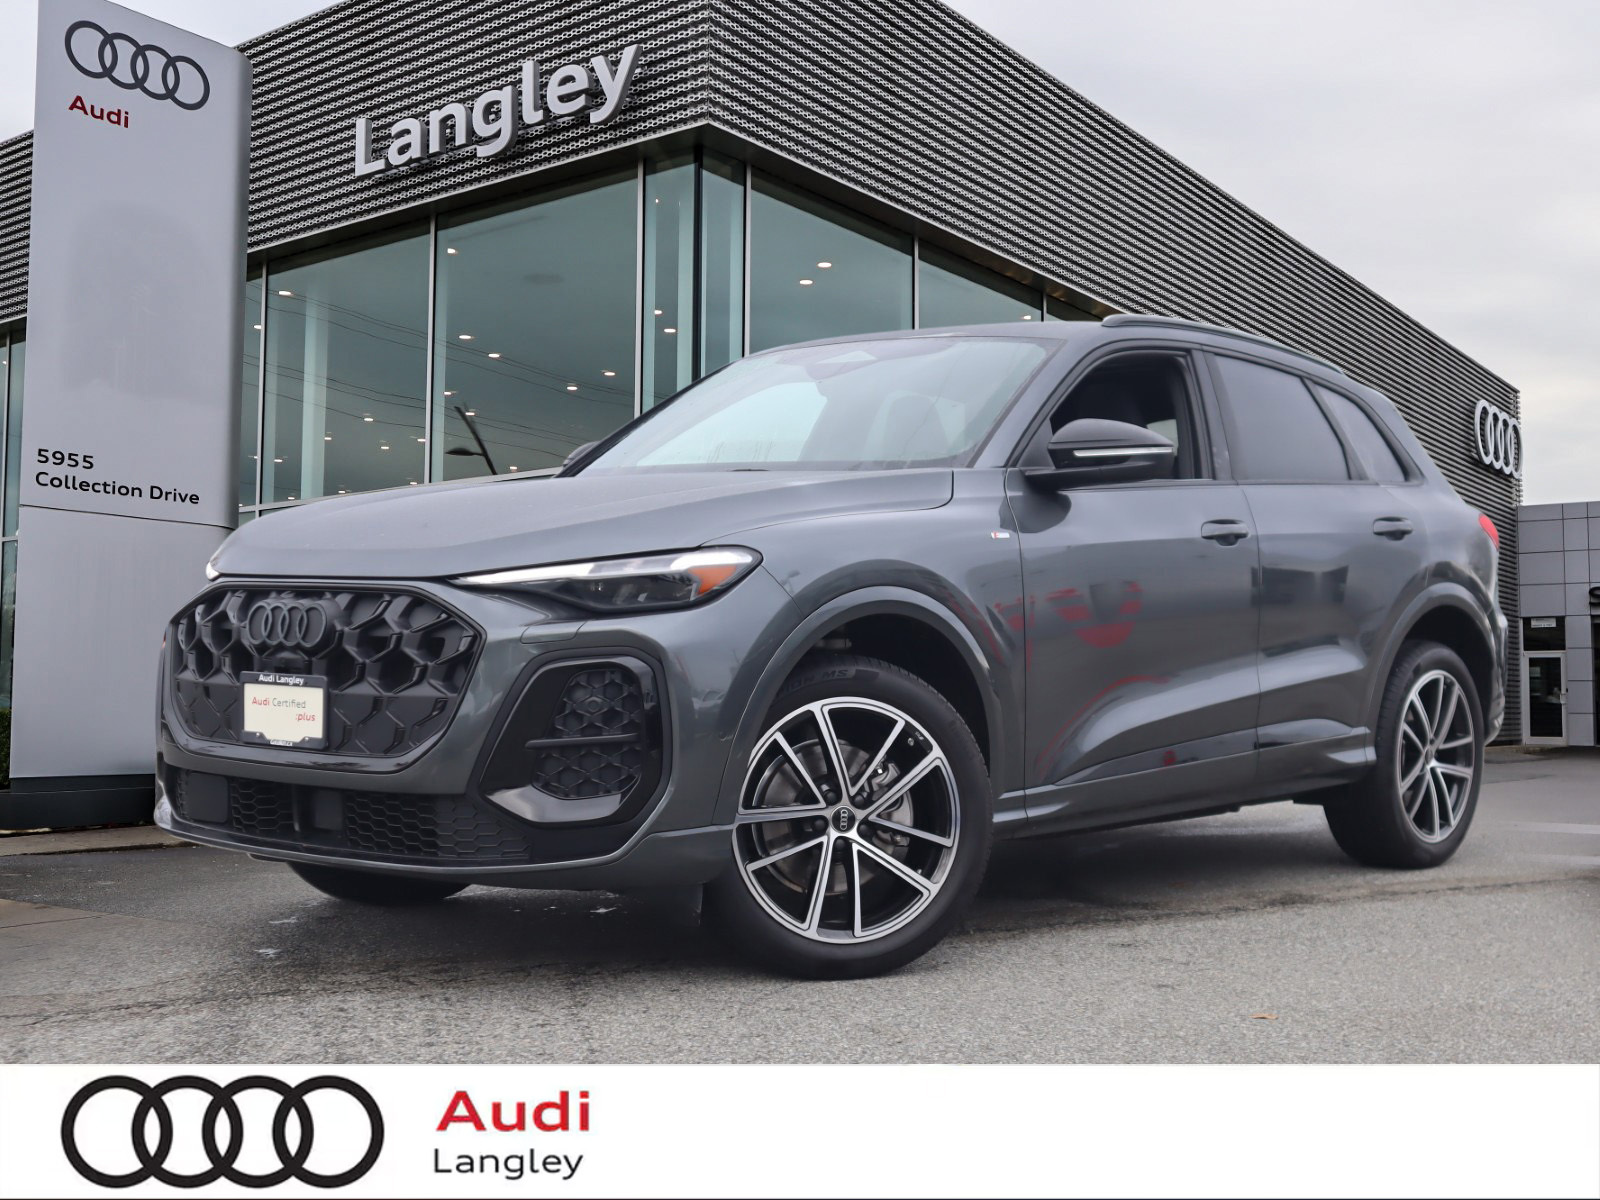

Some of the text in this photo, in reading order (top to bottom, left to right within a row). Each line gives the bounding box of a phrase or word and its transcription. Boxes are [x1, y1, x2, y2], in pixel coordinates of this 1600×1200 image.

[68, 95, 129, 128] Audi
[354, 44, 643, 177] Langley
[37, 448, 94, 470] 5955
[35, 471, 200, 505] Collection Drive
[259, 674, 304, 685] Audi Langley
[252, 697, 306, 708] Audi Certified
